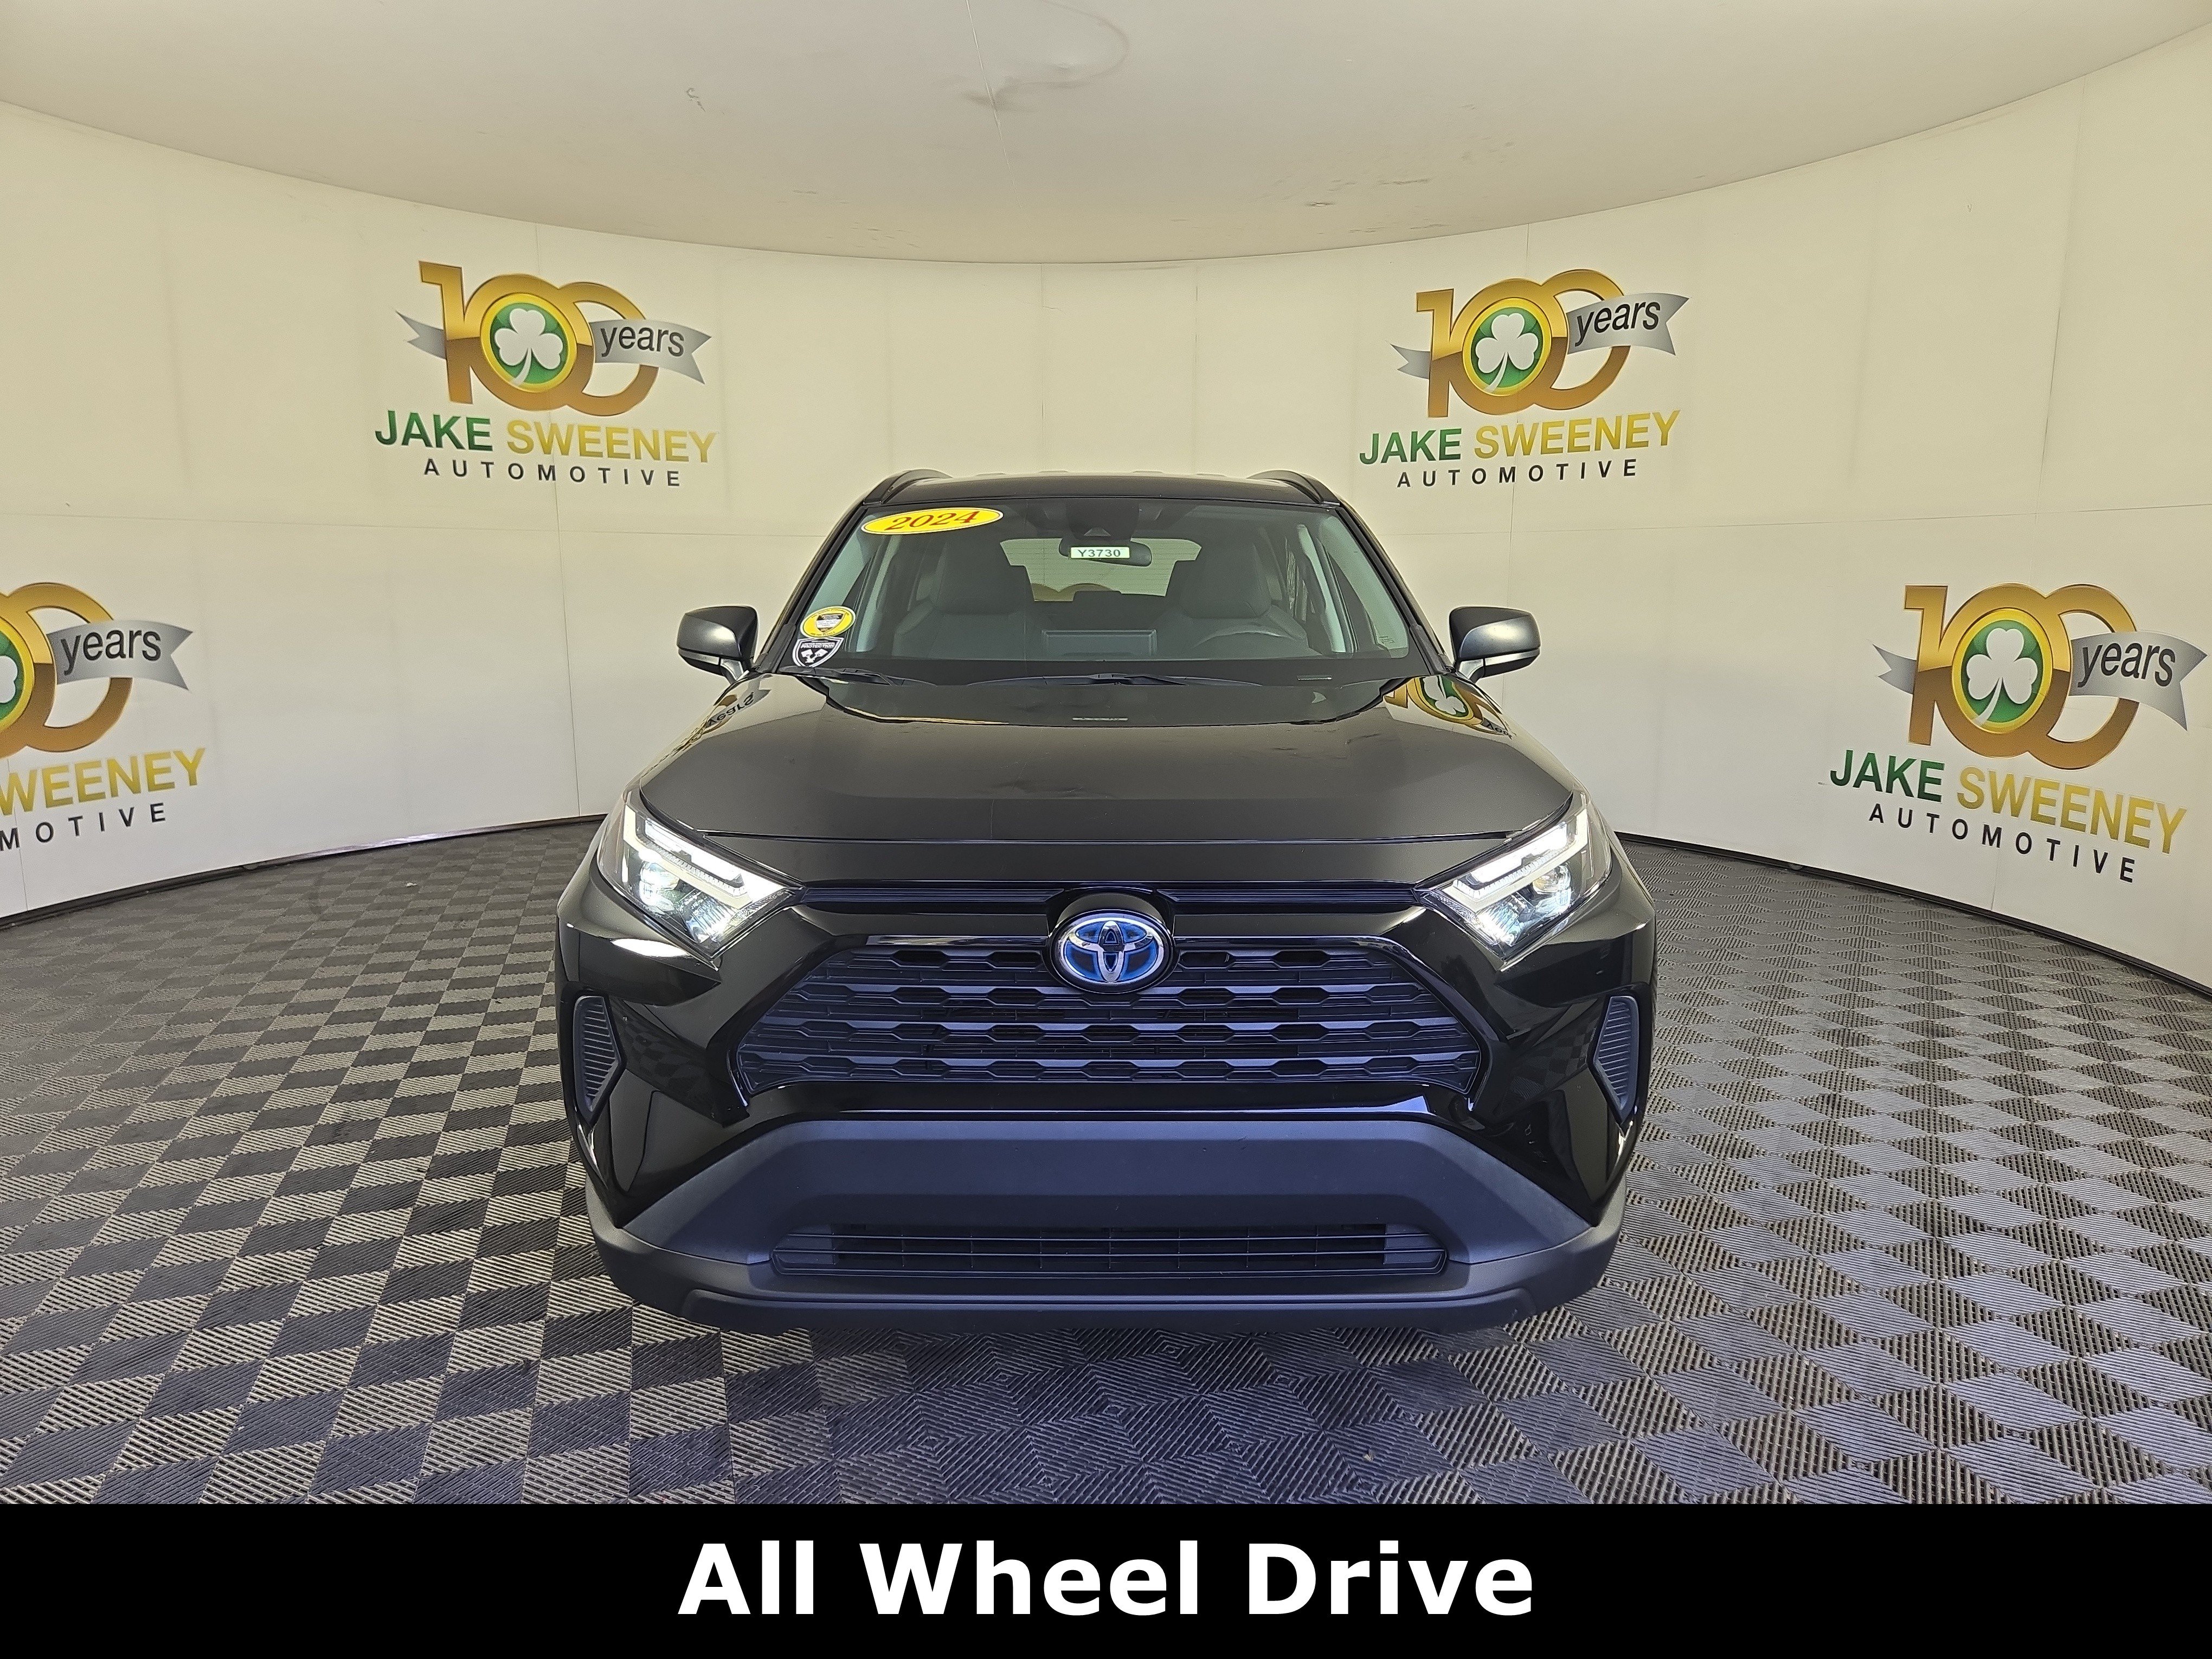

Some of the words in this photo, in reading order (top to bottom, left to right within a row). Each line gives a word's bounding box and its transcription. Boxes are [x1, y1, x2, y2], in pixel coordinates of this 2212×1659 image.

[600, 325, 685, 358] years
[1575, 301, 1661, 345] years
[374, 410, 493, 452] JAKE
[506, 419, 717, 463] SWEENEY
[1359, 428, 1462, 465] JAKE
[1474, 409, 1681, 459] SWEENEY
[424, 458, 680, 487] AUTOMOTIVE
[1397, 459, 1637, 488] AUTOMOTIVE
[884, 511, 980, 531] 2024
[1078, 549, 1121, 557] Y3730
[60, 629, 162, 676] years
[2078, 641, 2176, 687] years
[1829, 749, 1945, 802] JAKE
[1957, 766, 2187, 854] SWEENEY
[1869, 802, 2136, 883] AUTOMOTIVE
